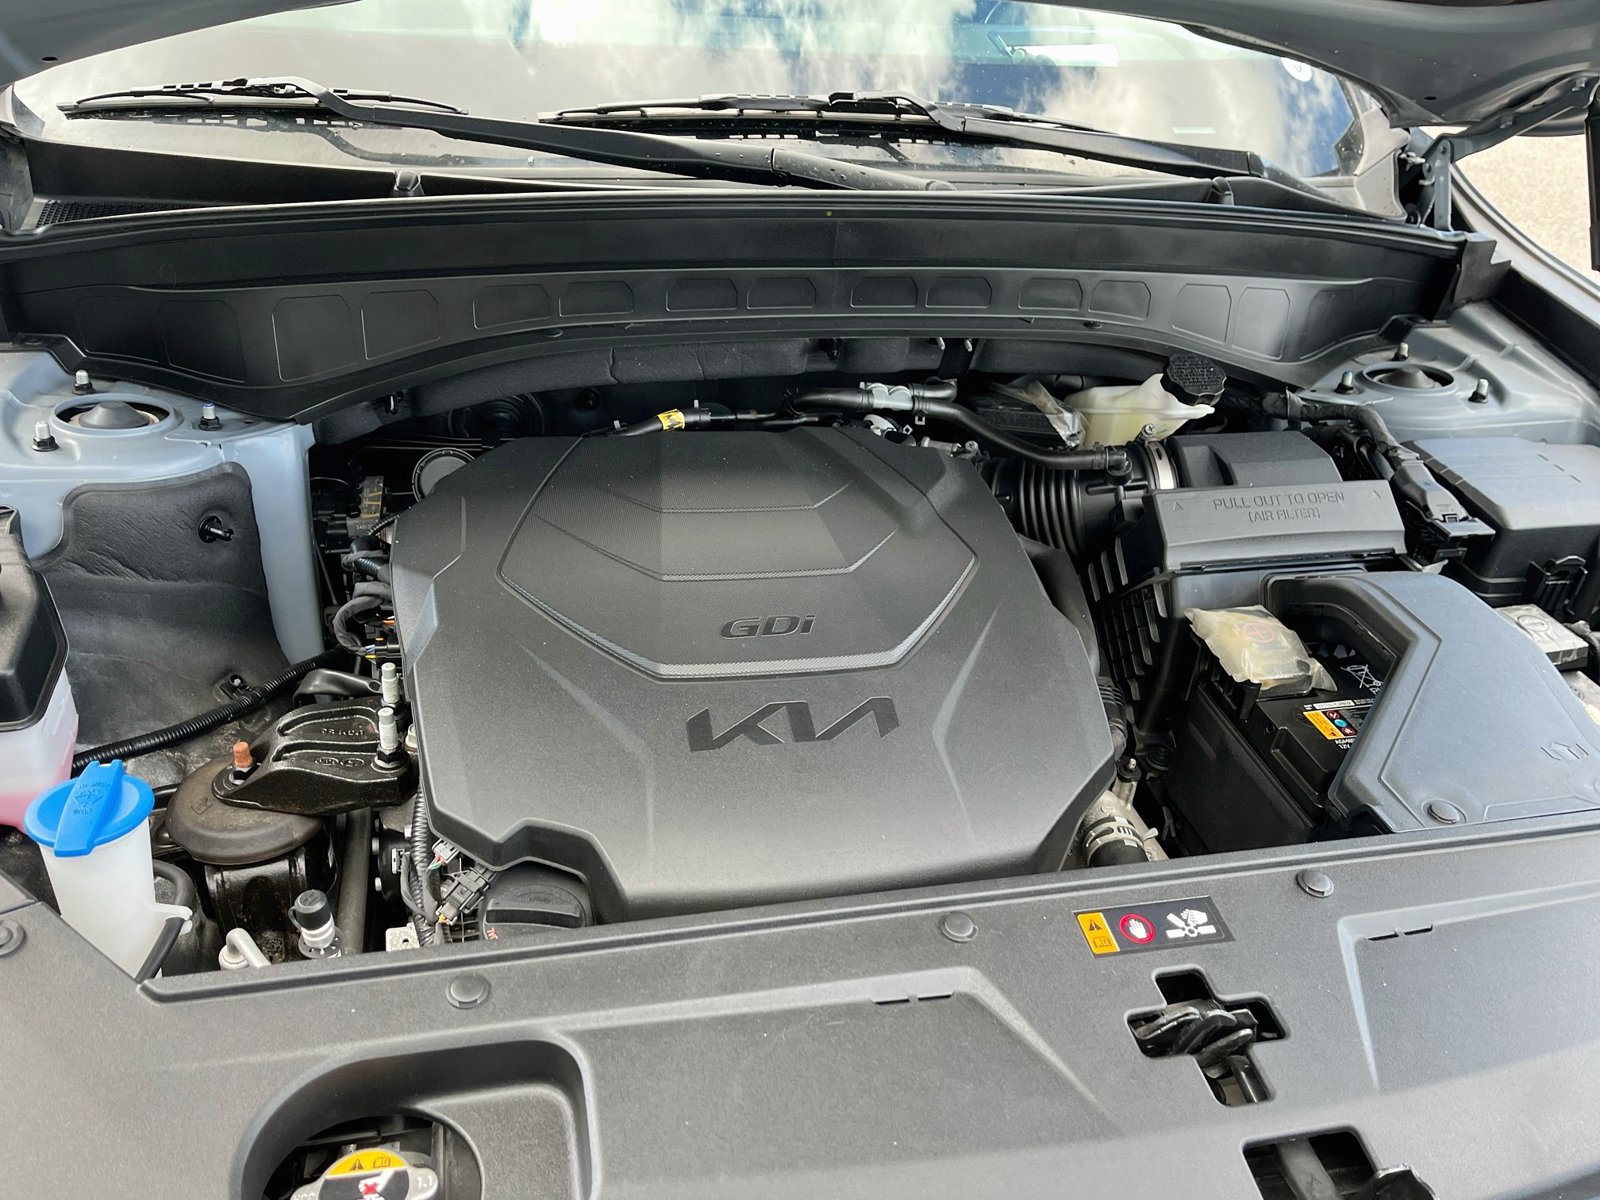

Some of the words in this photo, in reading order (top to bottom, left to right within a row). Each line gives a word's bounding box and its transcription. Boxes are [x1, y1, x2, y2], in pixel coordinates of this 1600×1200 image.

[1213, 498, 1251, 510] PULL
[1253, 495, 1282, 507] OUT
[1285, 493, 1305, 505] TO
[1307, 491, 1345, 504] OPEN
[1248, 510, 1274, 523] (AIR
[1276, 507, 1321, 520] FILTER)
[720, 614, 815, 639] GDi
[686, 696, 900, 751] KIA
[417, 1175, 433, 1188] 1.1
